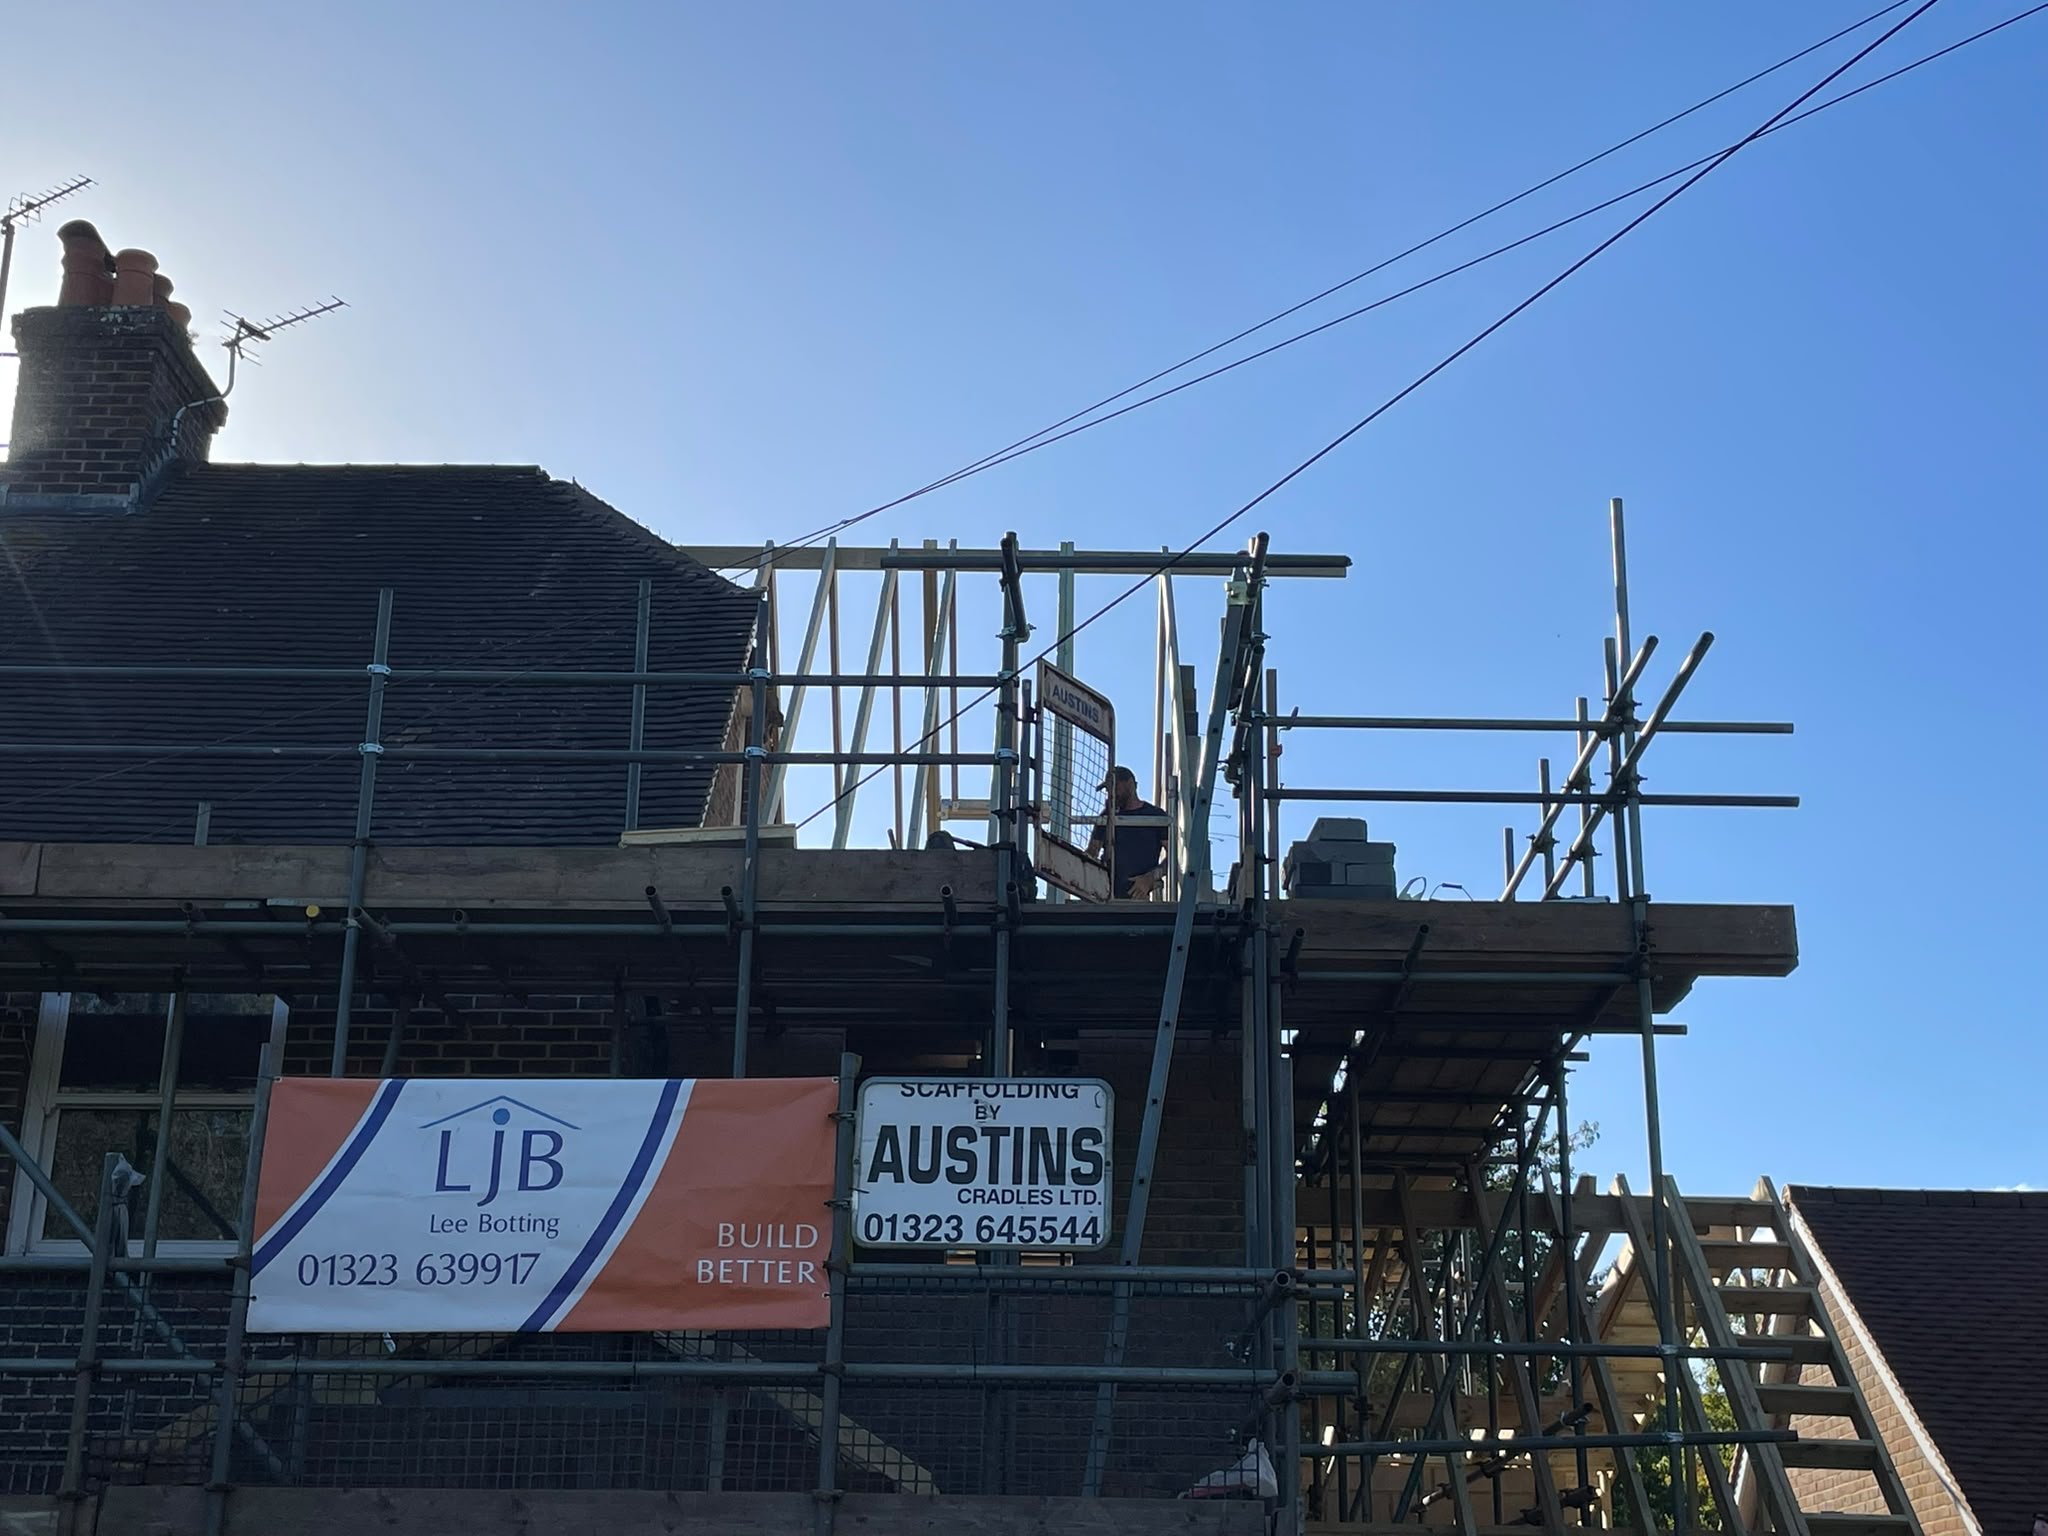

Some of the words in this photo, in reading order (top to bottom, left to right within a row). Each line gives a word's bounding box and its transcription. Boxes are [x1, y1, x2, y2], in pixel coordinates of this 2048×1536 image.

[1052, 685, 1099, 724] AUSTINS
[900, 1083, 1079, 1099] SCAFFOLDING
[975, 1105, 1001, 1120] BY
[867, 1125, 1103, 1186] AUSTINS
[957, 1188, 1053, 1205] CRADLES
[1059, 1190, 1102, 1206] LTD.
[430, 1214, 468, 1233] Lee
[479, 1213, 560, 1239] Botting
[717, 1223, 819, 1249] BUILD
[864, 1213, 964, 1242] 01323
[976, 1215, 1100, 1244] 645544
[298, 1253, 399, 1286] 01323
[416, 1253, 540, 1285] 639917
[697, 1260, 817, 1284] BETTER
